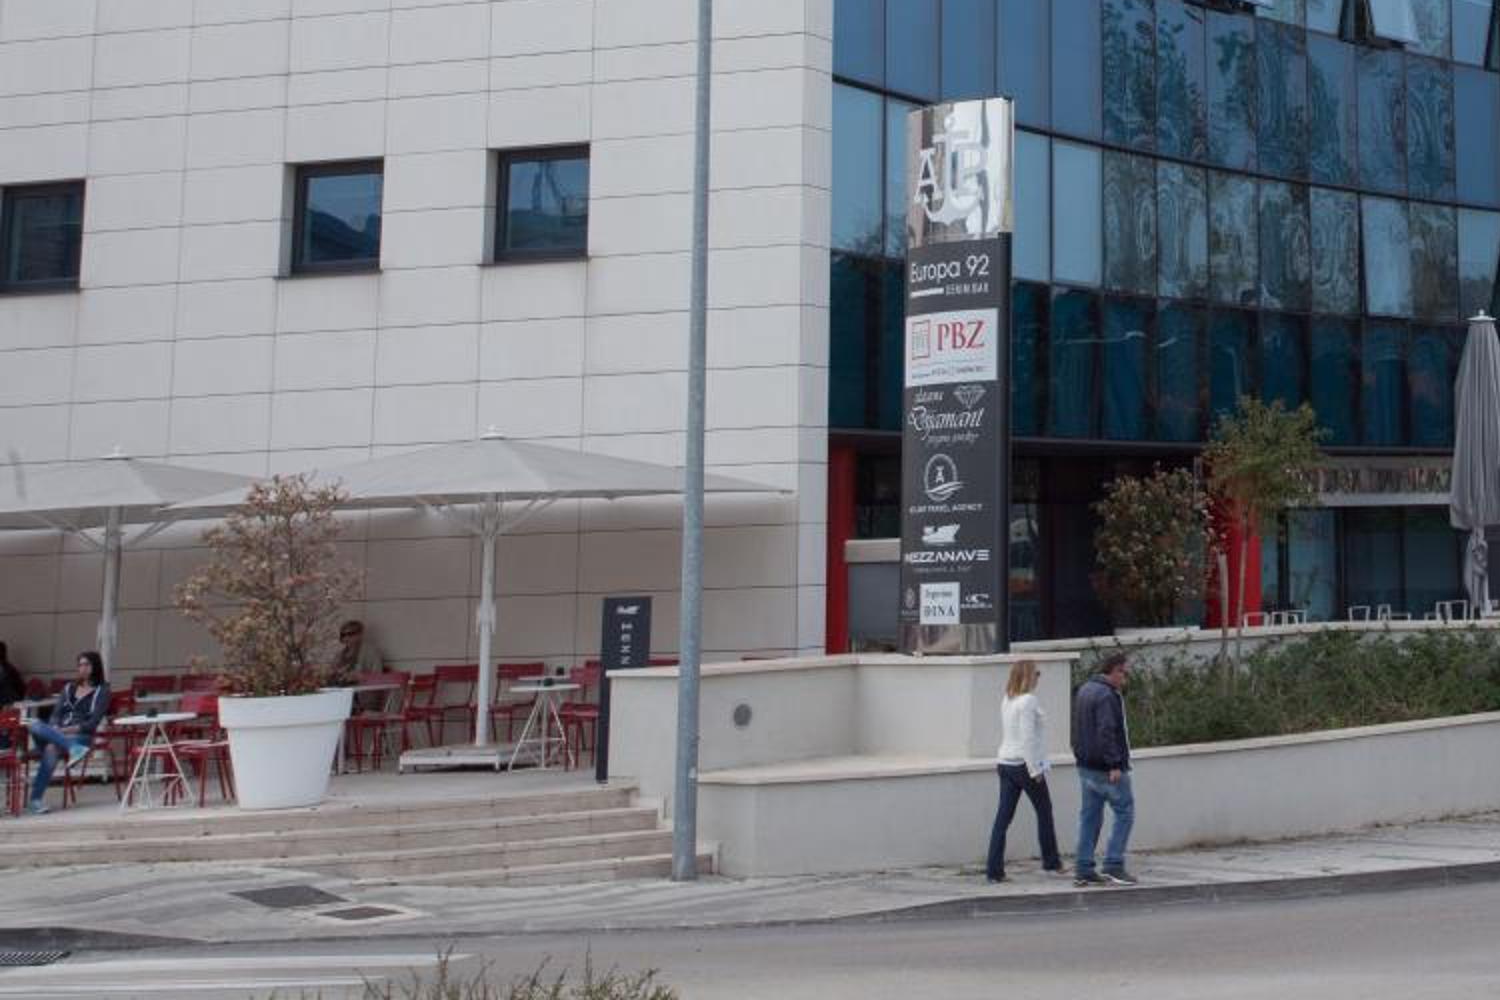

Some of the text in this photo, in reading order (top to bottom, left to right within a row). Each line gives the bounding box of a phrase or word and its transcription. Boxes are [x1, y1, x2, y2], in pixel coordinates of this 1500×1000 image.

[911, 254, 989, 284] Europa 92
[937, 320, 985, 351] PBZ
